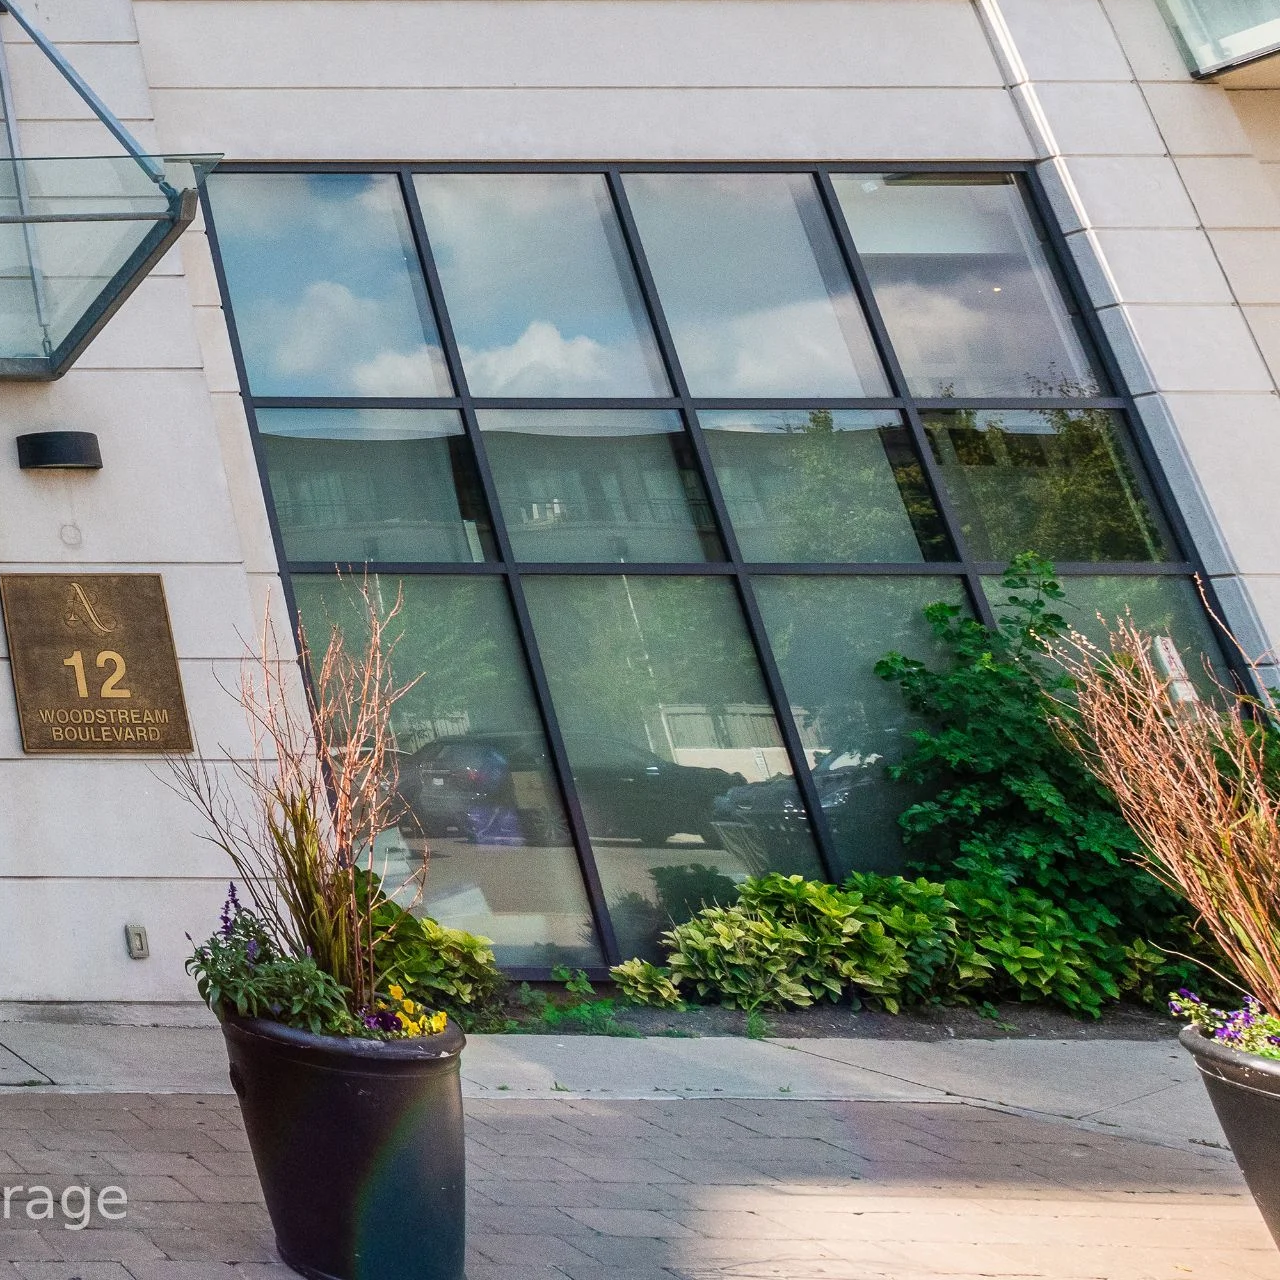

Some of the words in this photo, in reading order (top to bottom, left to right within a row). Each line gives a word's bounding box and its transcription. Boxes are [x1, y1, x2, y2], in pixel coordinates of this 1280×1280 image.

[63, 650, 132, 698] 12
[39, 709, 169, 724] WOODSTREAM
[51, 726, 161, 742] BOULEVARD
